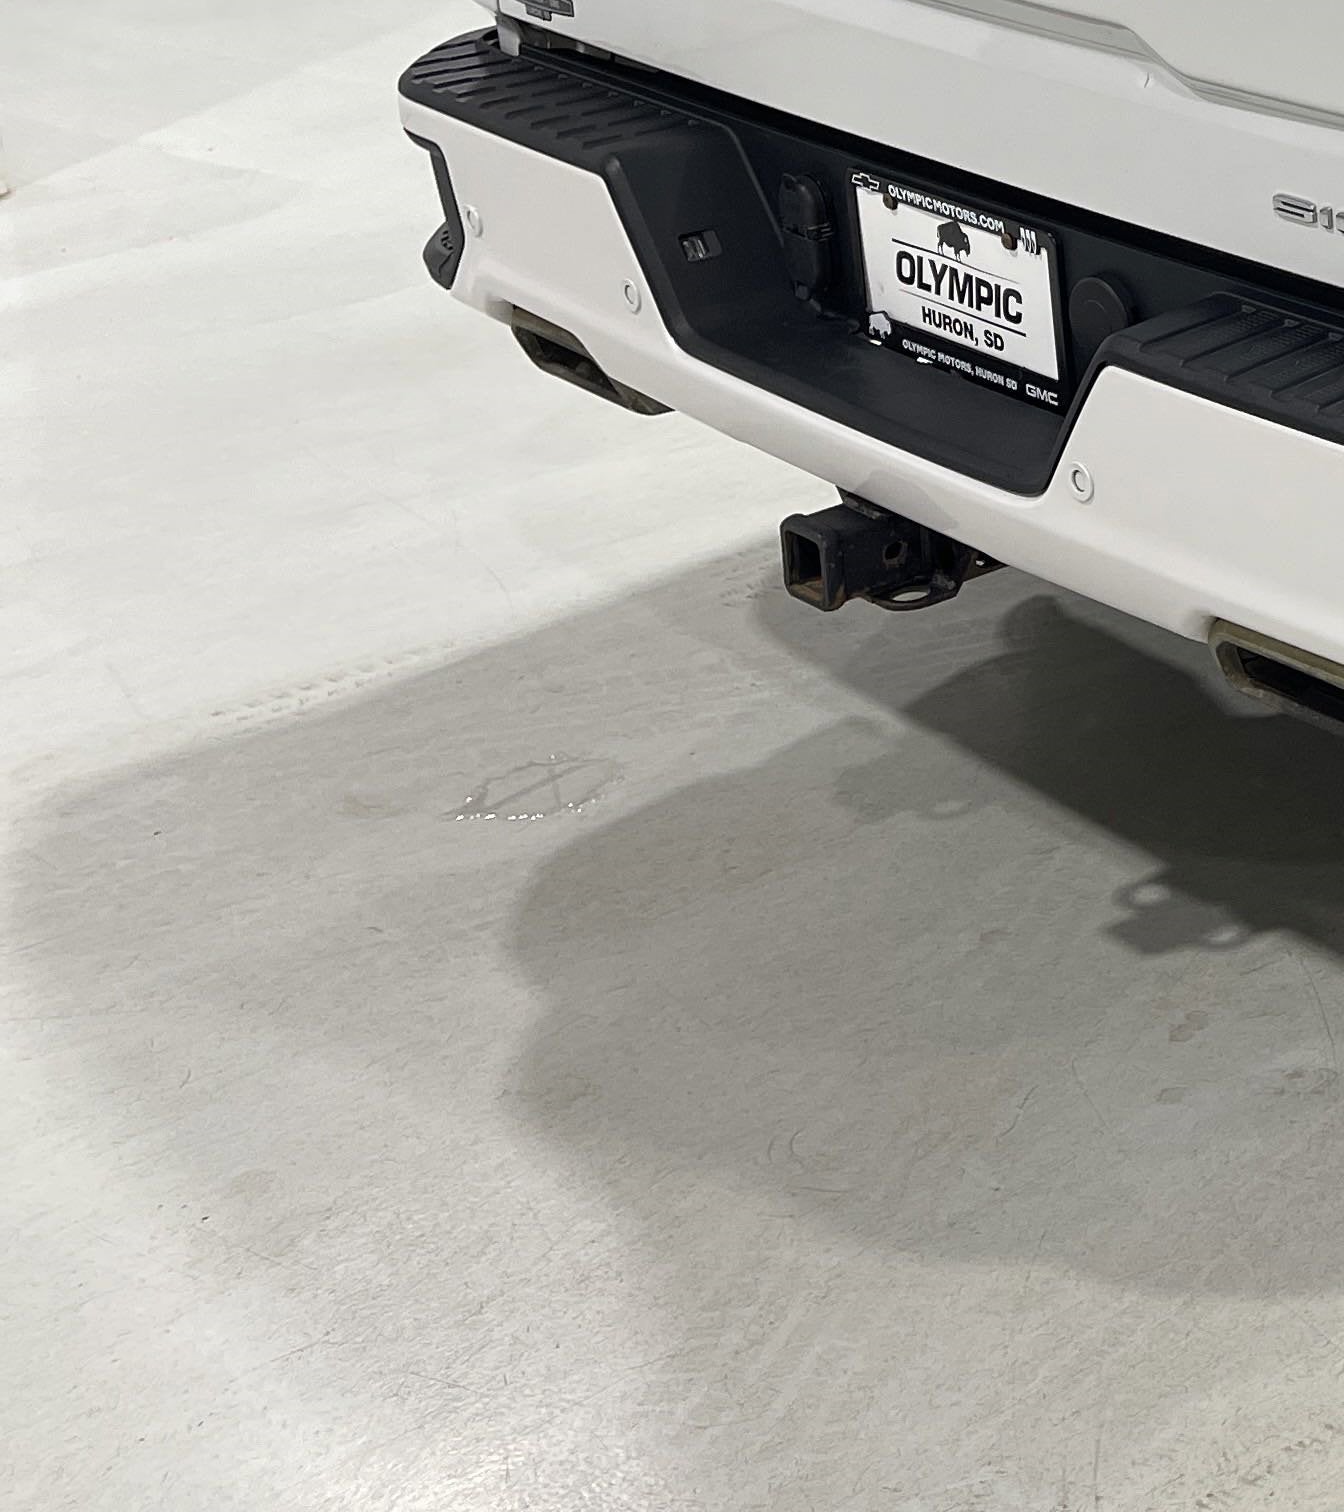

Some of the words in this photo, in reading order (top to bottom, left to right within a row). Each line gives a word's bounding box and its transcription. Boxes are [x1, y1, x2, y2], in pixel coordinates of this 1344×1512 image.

[888, 184, 1005, 234] OLYMPICMOTORS.COM
[895, 250, 1023, 325] OLYMPIC
[921, 305, 979, 347] HURON,
[984, 329, 1005, 352] SD
[902, 338, 937, 360] OLYMPIC
[937, 352, 974, 376] MOTORS,
[975, 366, 1004, 386] HURON
[1005, 377, 1018, 391] SD
[1025, 383, 1059, 406] GMC
